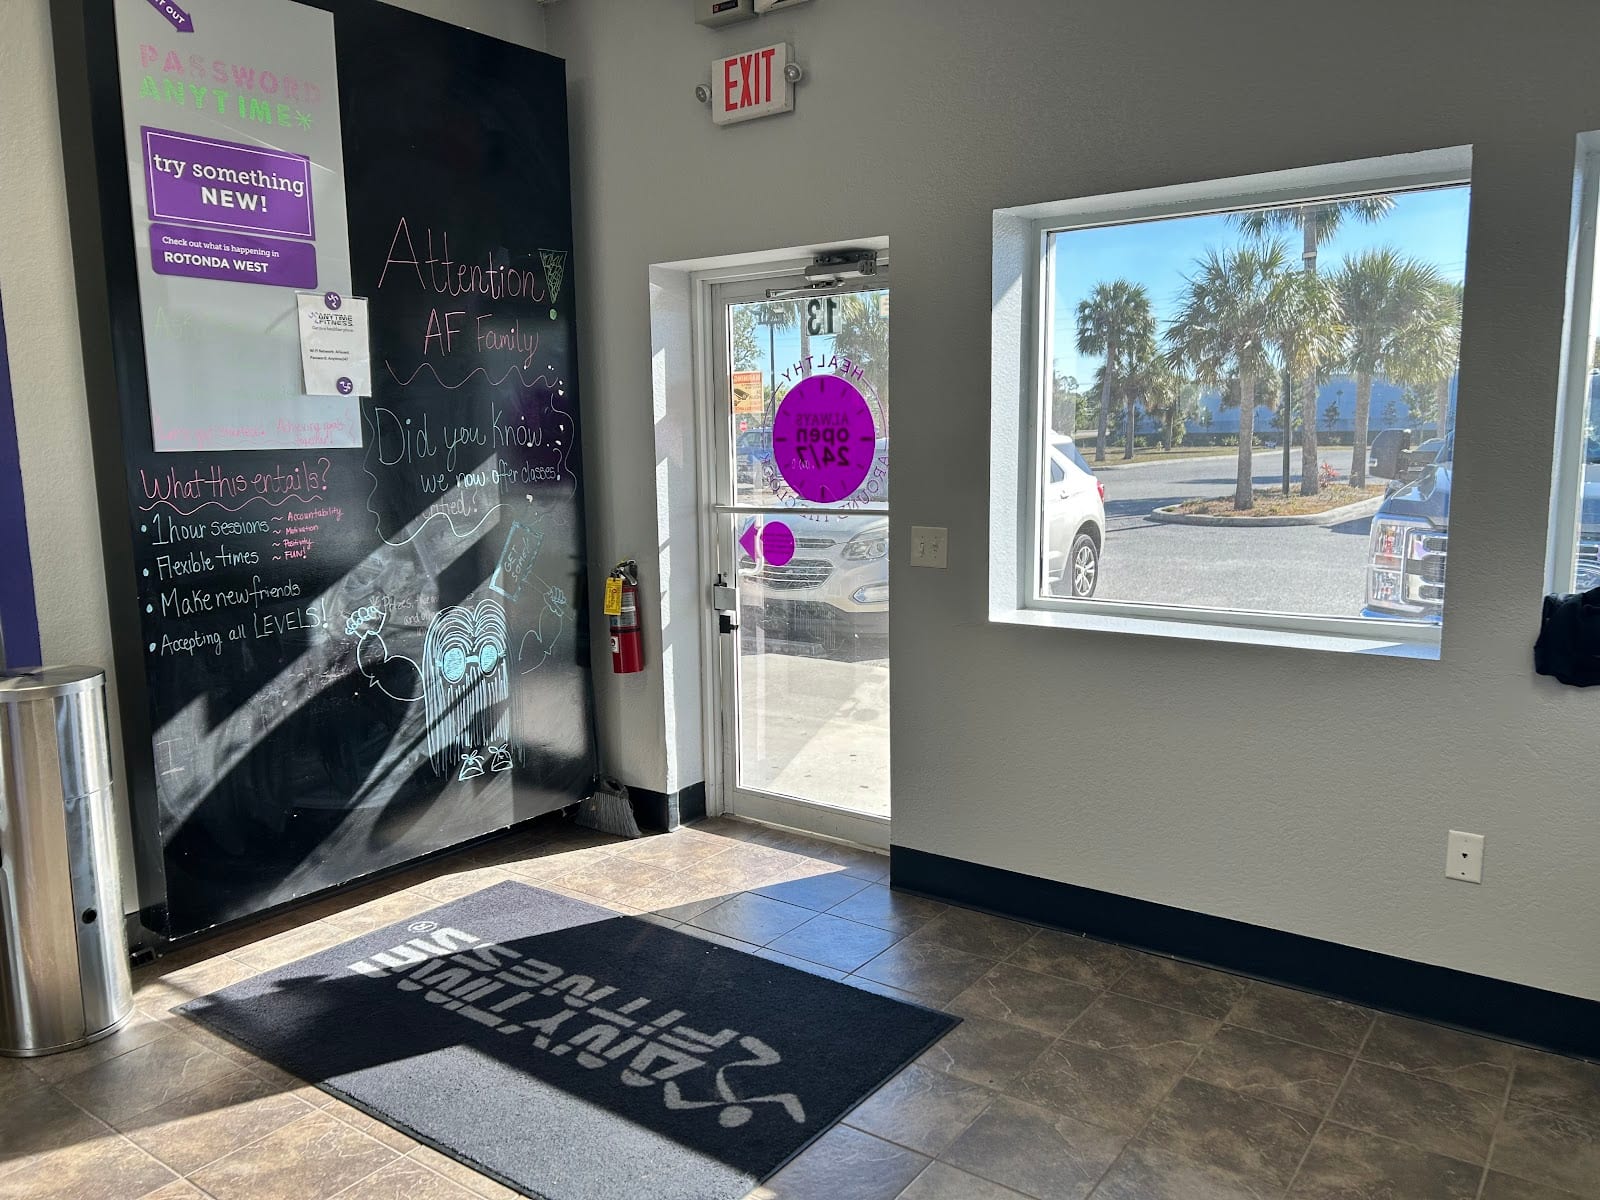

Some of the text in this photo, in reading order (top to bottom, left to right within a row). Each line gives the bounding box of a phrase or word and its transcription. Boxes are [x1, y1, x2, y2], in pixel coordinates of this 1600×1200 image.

[165, 5, 186, 24] OUT
[140, 44, 321, 105] PASSWORD
[724, 48, 775, 112] EXIT
[153, 153, 305, 197] try something
[201, 186, 268, 213] NEW!
[162, 235, 280, 258] Check out what is happening in
[164, 251, 269, 273] ROTONDA WEST
[424, 308, 539, 368] AF Family
[375, 407, 437, 465] Did
[444, 426, 487, 472] you
[140, 457, 331, 500] What this entails?
[457, 471, 486, 489] now
[152, 512, 270, 546] 1 hour sessions
[287, 506, 344, 522] Accountability
[156, 544, 259, 581] Flexible times
[284, 547, 308, 560] FUN!
[161, 575, 301, 618] Make new friends
[161, 597, 329, 656] Accepting all LEVELS!
[430, 926, 742, 1054] FITNESS
[346, 937, 707, 1088] ANYTIME
